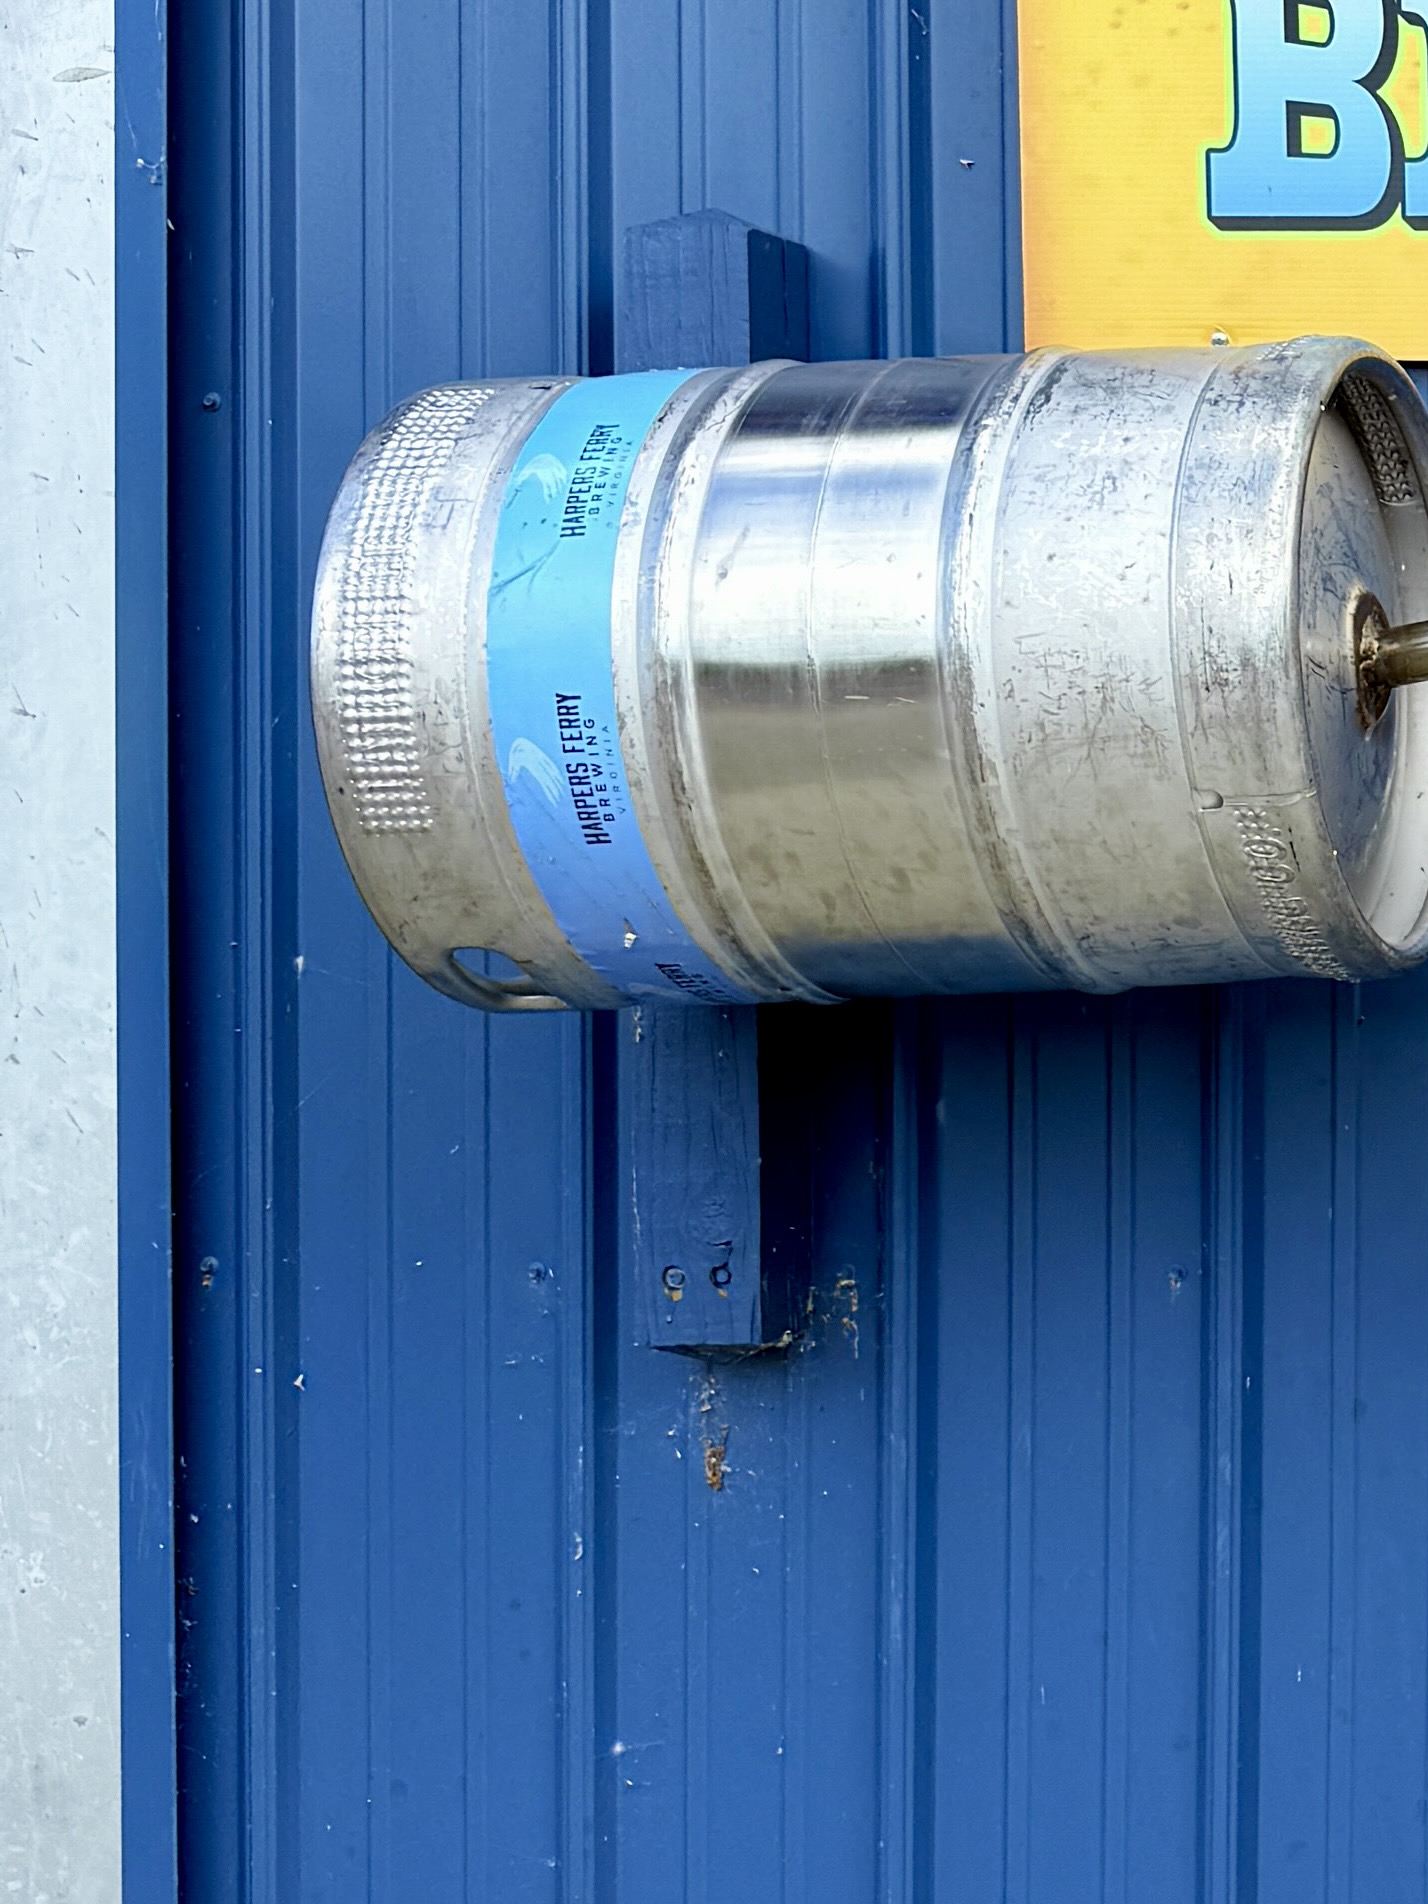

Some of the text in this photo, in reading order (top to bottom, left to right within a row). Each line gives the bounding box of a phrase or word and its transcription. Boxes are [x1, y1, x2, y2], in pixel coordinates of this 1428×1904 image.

[560, 424, 620, 538] HARPERS FERRY
[588, 436, 623, 516] BREWING
[555, 692, 613, 845] HARPERS FERRY
[583, 718, 616, 823] BREWING
